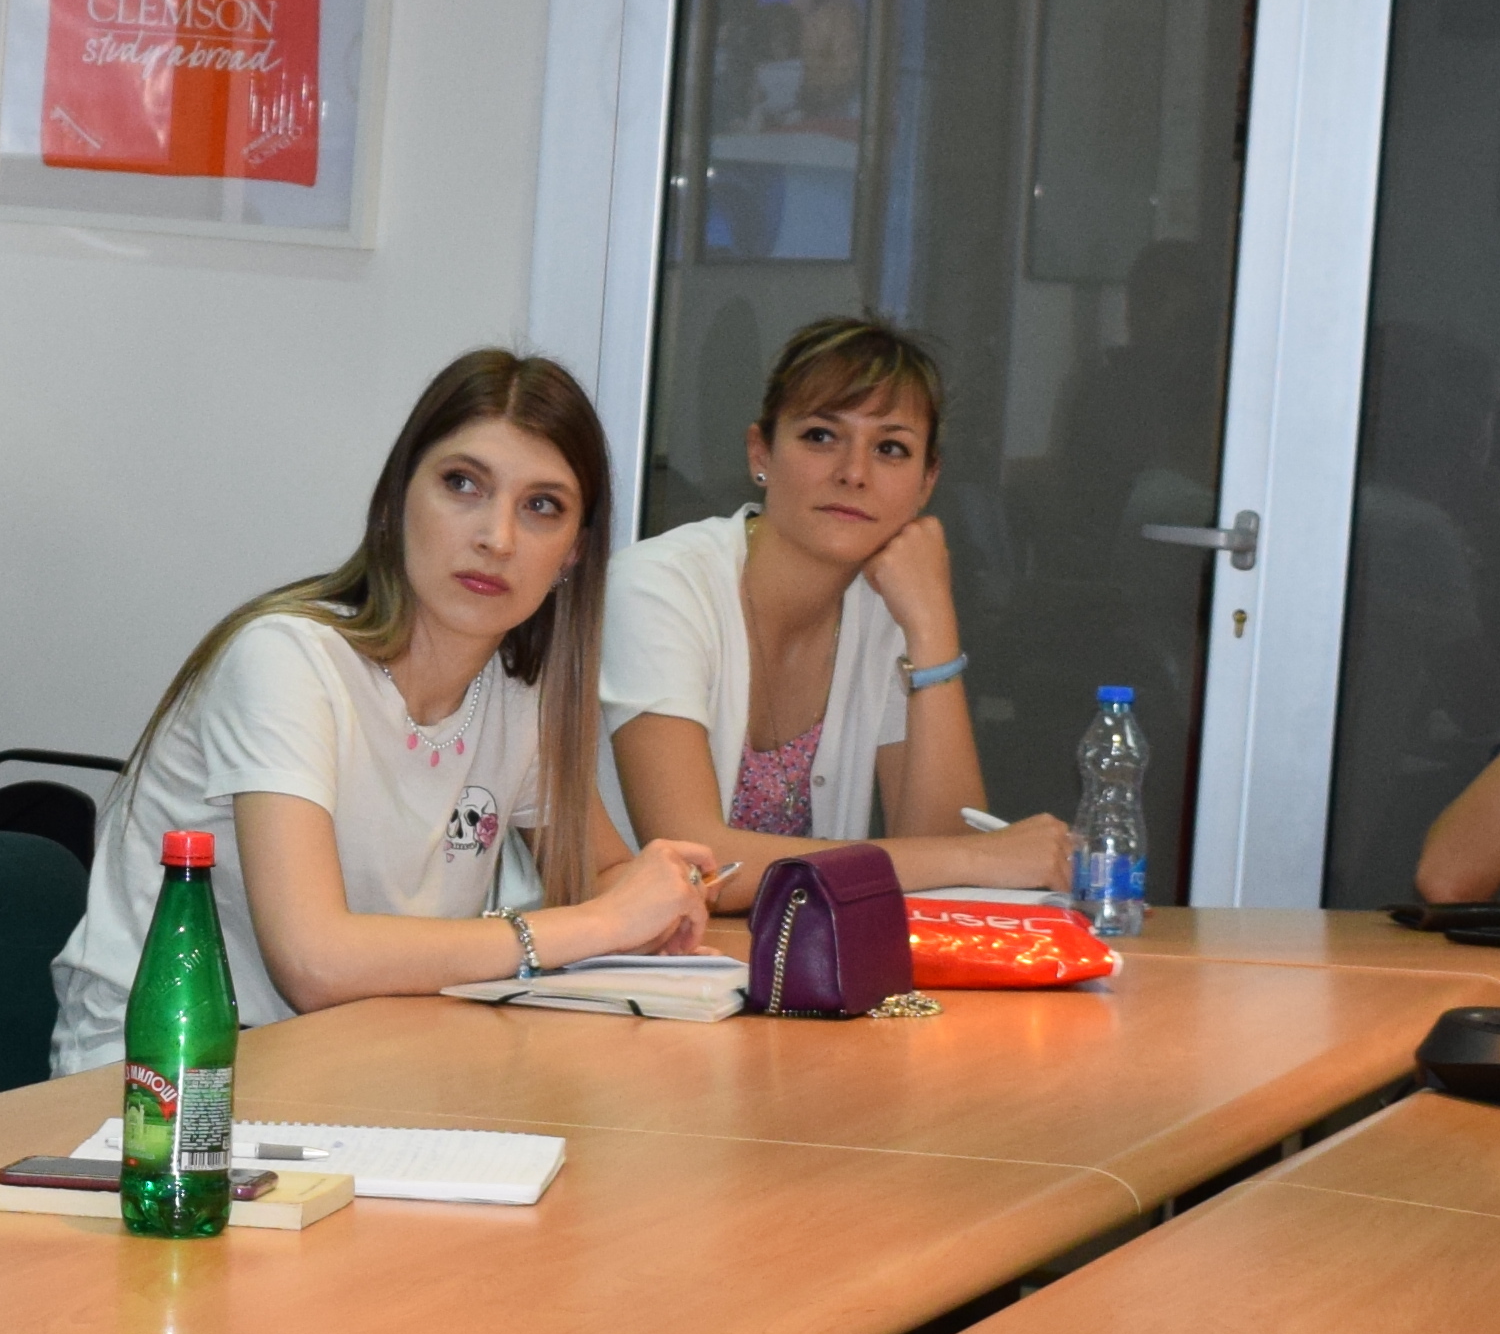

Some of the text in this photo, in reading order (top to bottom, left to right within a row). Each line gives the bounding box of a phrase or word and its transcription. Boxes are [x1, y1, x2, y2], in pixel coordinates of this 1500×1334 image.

[81, 28, 283, 81] study abroad
[129, 1063, 179, 1104] МИЛОШ
